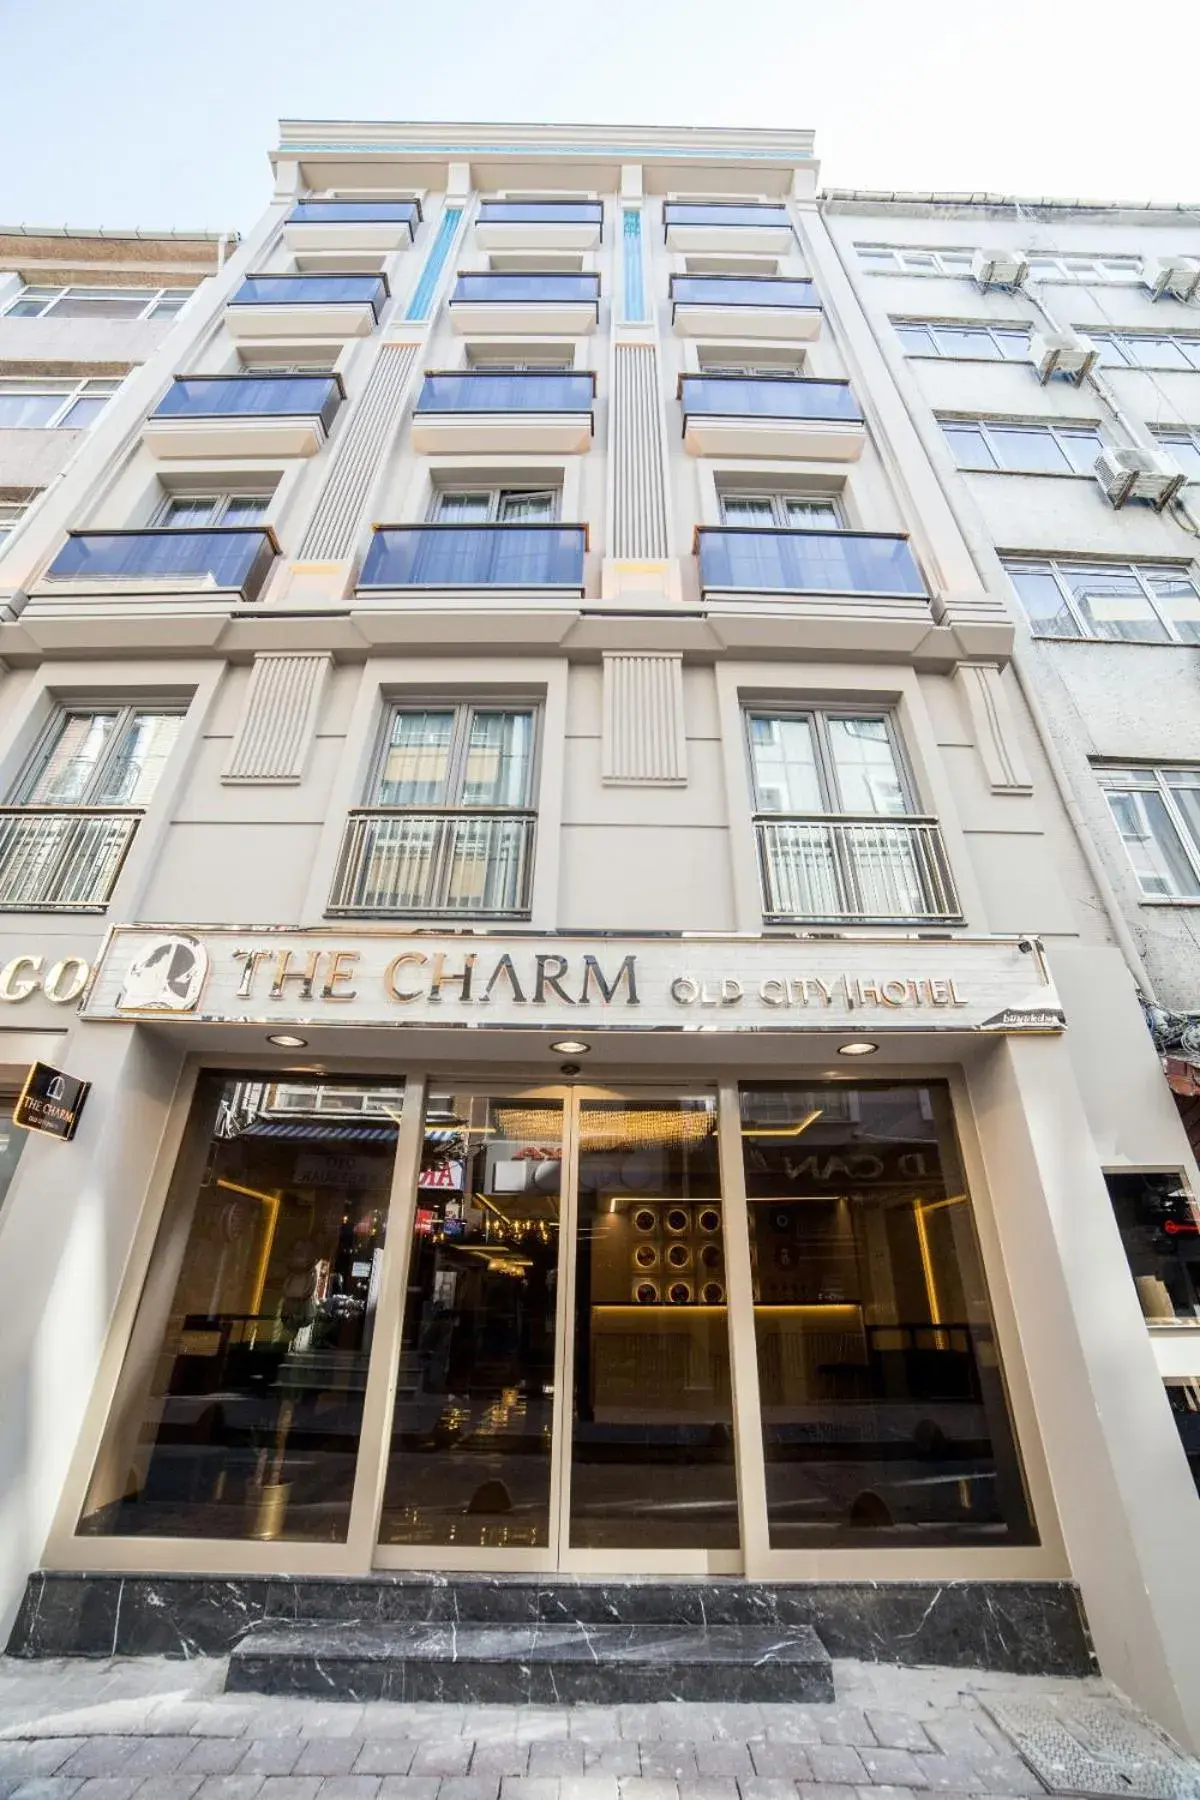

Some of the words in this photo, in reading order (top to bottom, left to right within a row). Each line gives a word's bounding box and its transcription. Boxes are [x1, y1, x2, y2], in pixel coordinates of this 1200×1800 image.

[232, 950, 361, 1002] THE
[384, 951, 641, 1005] CHARM
[671, 977, 744, 1005] OLD
[759, 978, 835, 1006] CITY
[855, 978, 969, 1008] HOTEL
[24, 1095, 43, 1112] THE
[42, 1103, 74, 1123] CHARM
